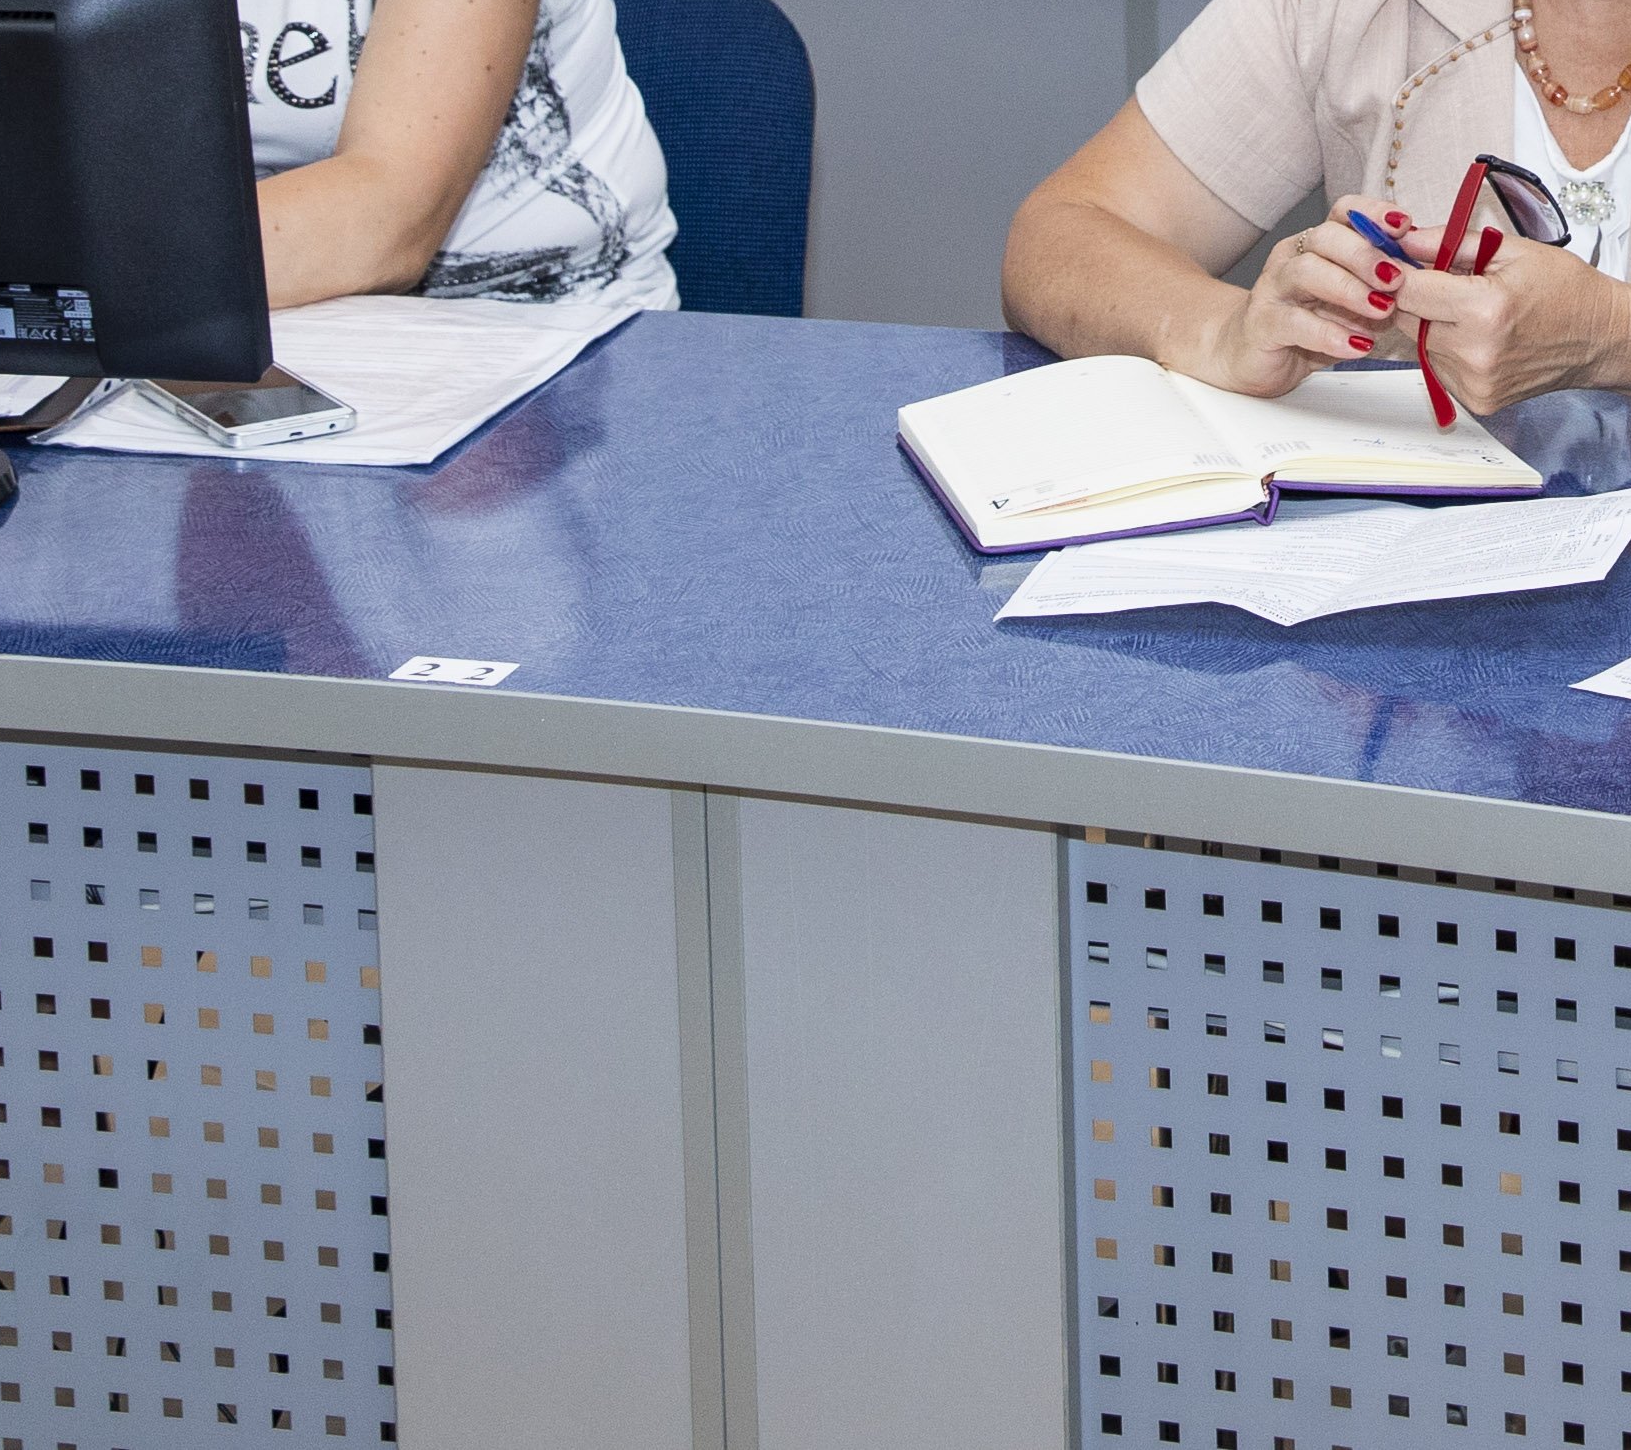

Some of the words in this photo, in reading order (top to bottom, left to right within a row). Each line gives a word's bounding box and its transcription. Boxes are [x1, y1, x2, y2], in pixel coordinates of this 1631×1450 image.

[989, 498, 1009, 510] 4
[409, 663, 441, 677] 2
[463, 667, 495, 681] 2
